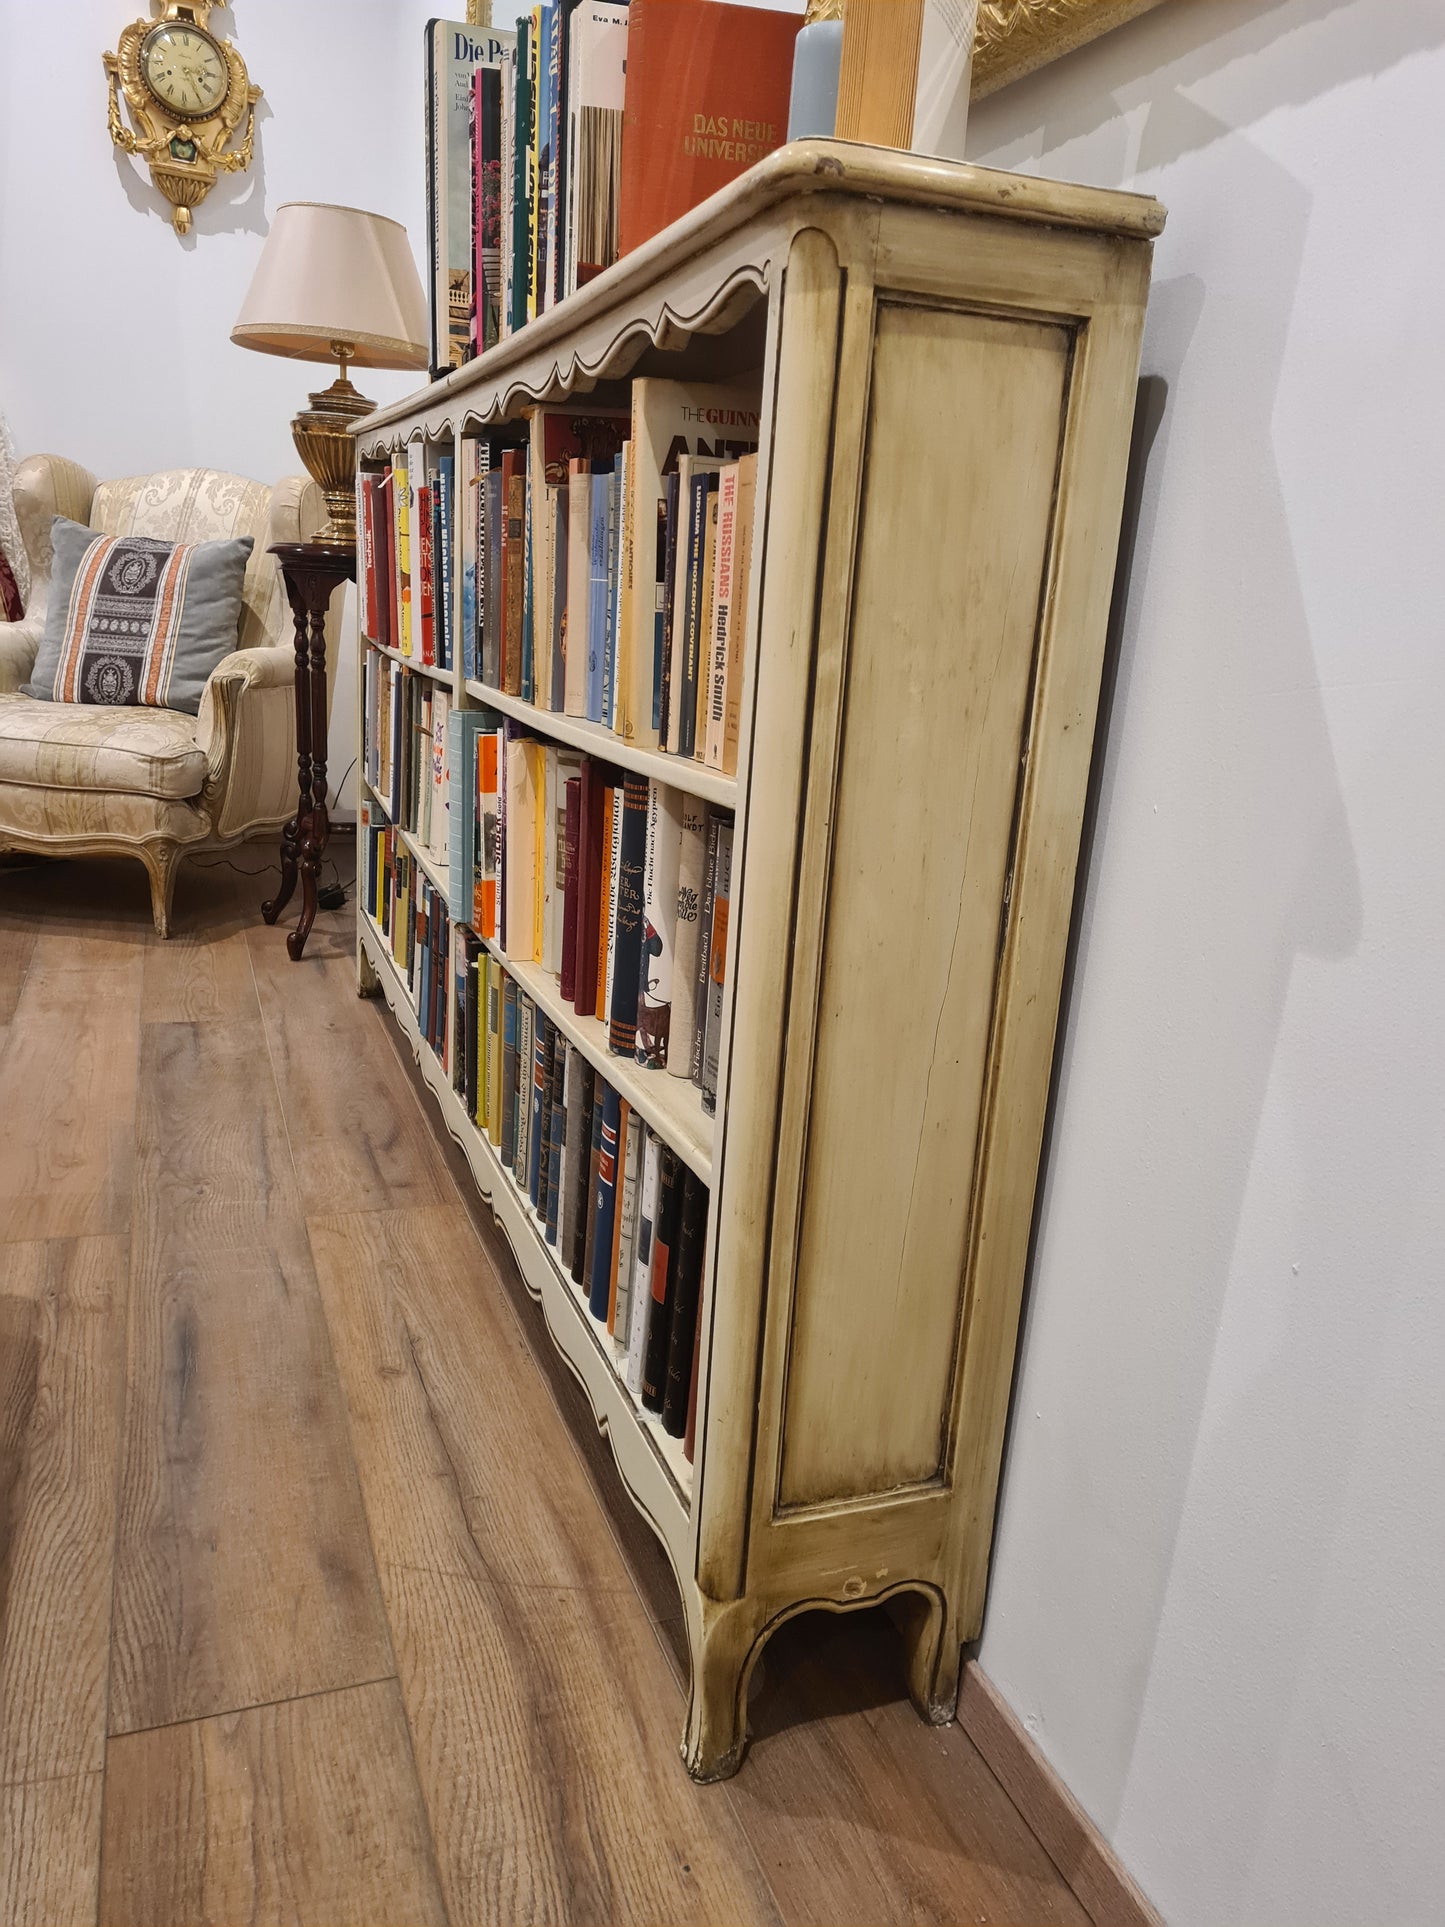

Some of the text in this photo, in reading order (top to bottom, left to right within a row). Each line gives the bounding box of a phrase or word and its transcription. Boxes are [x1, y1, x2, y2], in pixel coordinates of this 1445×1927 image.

[592, 15, 609, 23] Eva
[454, 32, 484, 62] Die
[693, 114, 777, 143] DAS NEUE
[684, 136, 770, 162] UNIVERS
[681, 406, 760, 427] THE GUINN
[694, 485, 702, 534] LUDLUM
[365, 530, 373, 568] Technik
[690, 560, 699, 619] HOLCROFT
[712, 475, 735, 721] THE RUSSIANS Hedrick Smith
[687, 621, 696, 682] COVENANT
[698, 930, 709, 984] Breitbach
[705, 859, 713, 888] blaue
[709, 823, 717, 857] Bidet
